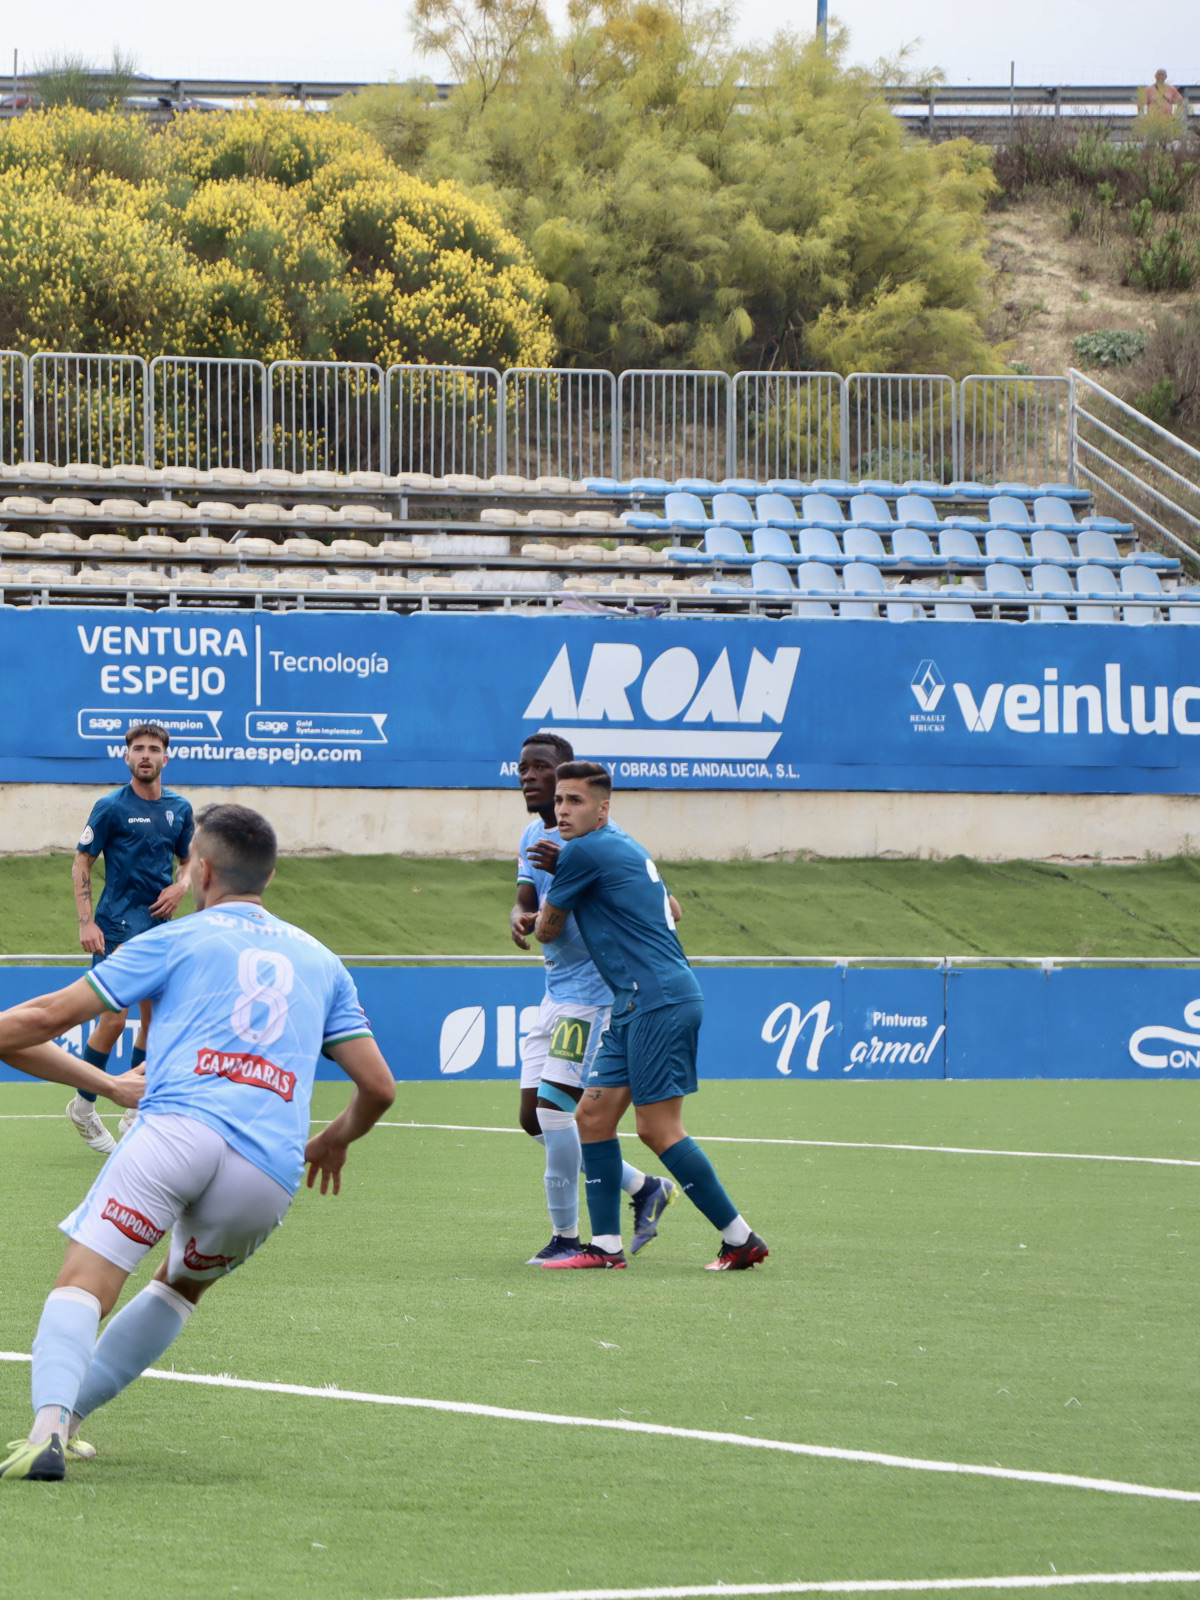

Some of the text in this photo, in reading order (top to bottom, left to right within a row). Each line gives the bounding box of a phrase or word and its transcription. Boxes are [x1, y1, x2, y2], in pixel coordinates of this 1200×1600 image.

[77, 625, 248, 657] VENTURA
[269, 651, 389, 678] Tecnología
[100, 665, 226, 701] ESPEJO
[522, 642, 802, 724] AROAN
[89, 718, 122, 731] sage
[256, 721, 288, 734] sage
[910, 714, 946, 722] RENAULT
[913, 724, 945, 732] TRUCKS
[620, 762, 668, 777] OBRAS
[671, 763, 689, 777] DE
[692, 763, 773, 779] ANDALUCIA,
[776, 765, 801, 779] S.L.
[230, 948, 294, 1046] 8
[873, 1012, 928, 1028] Pinturas
[200, 1053, 291, 1094] CAMPOARAS
